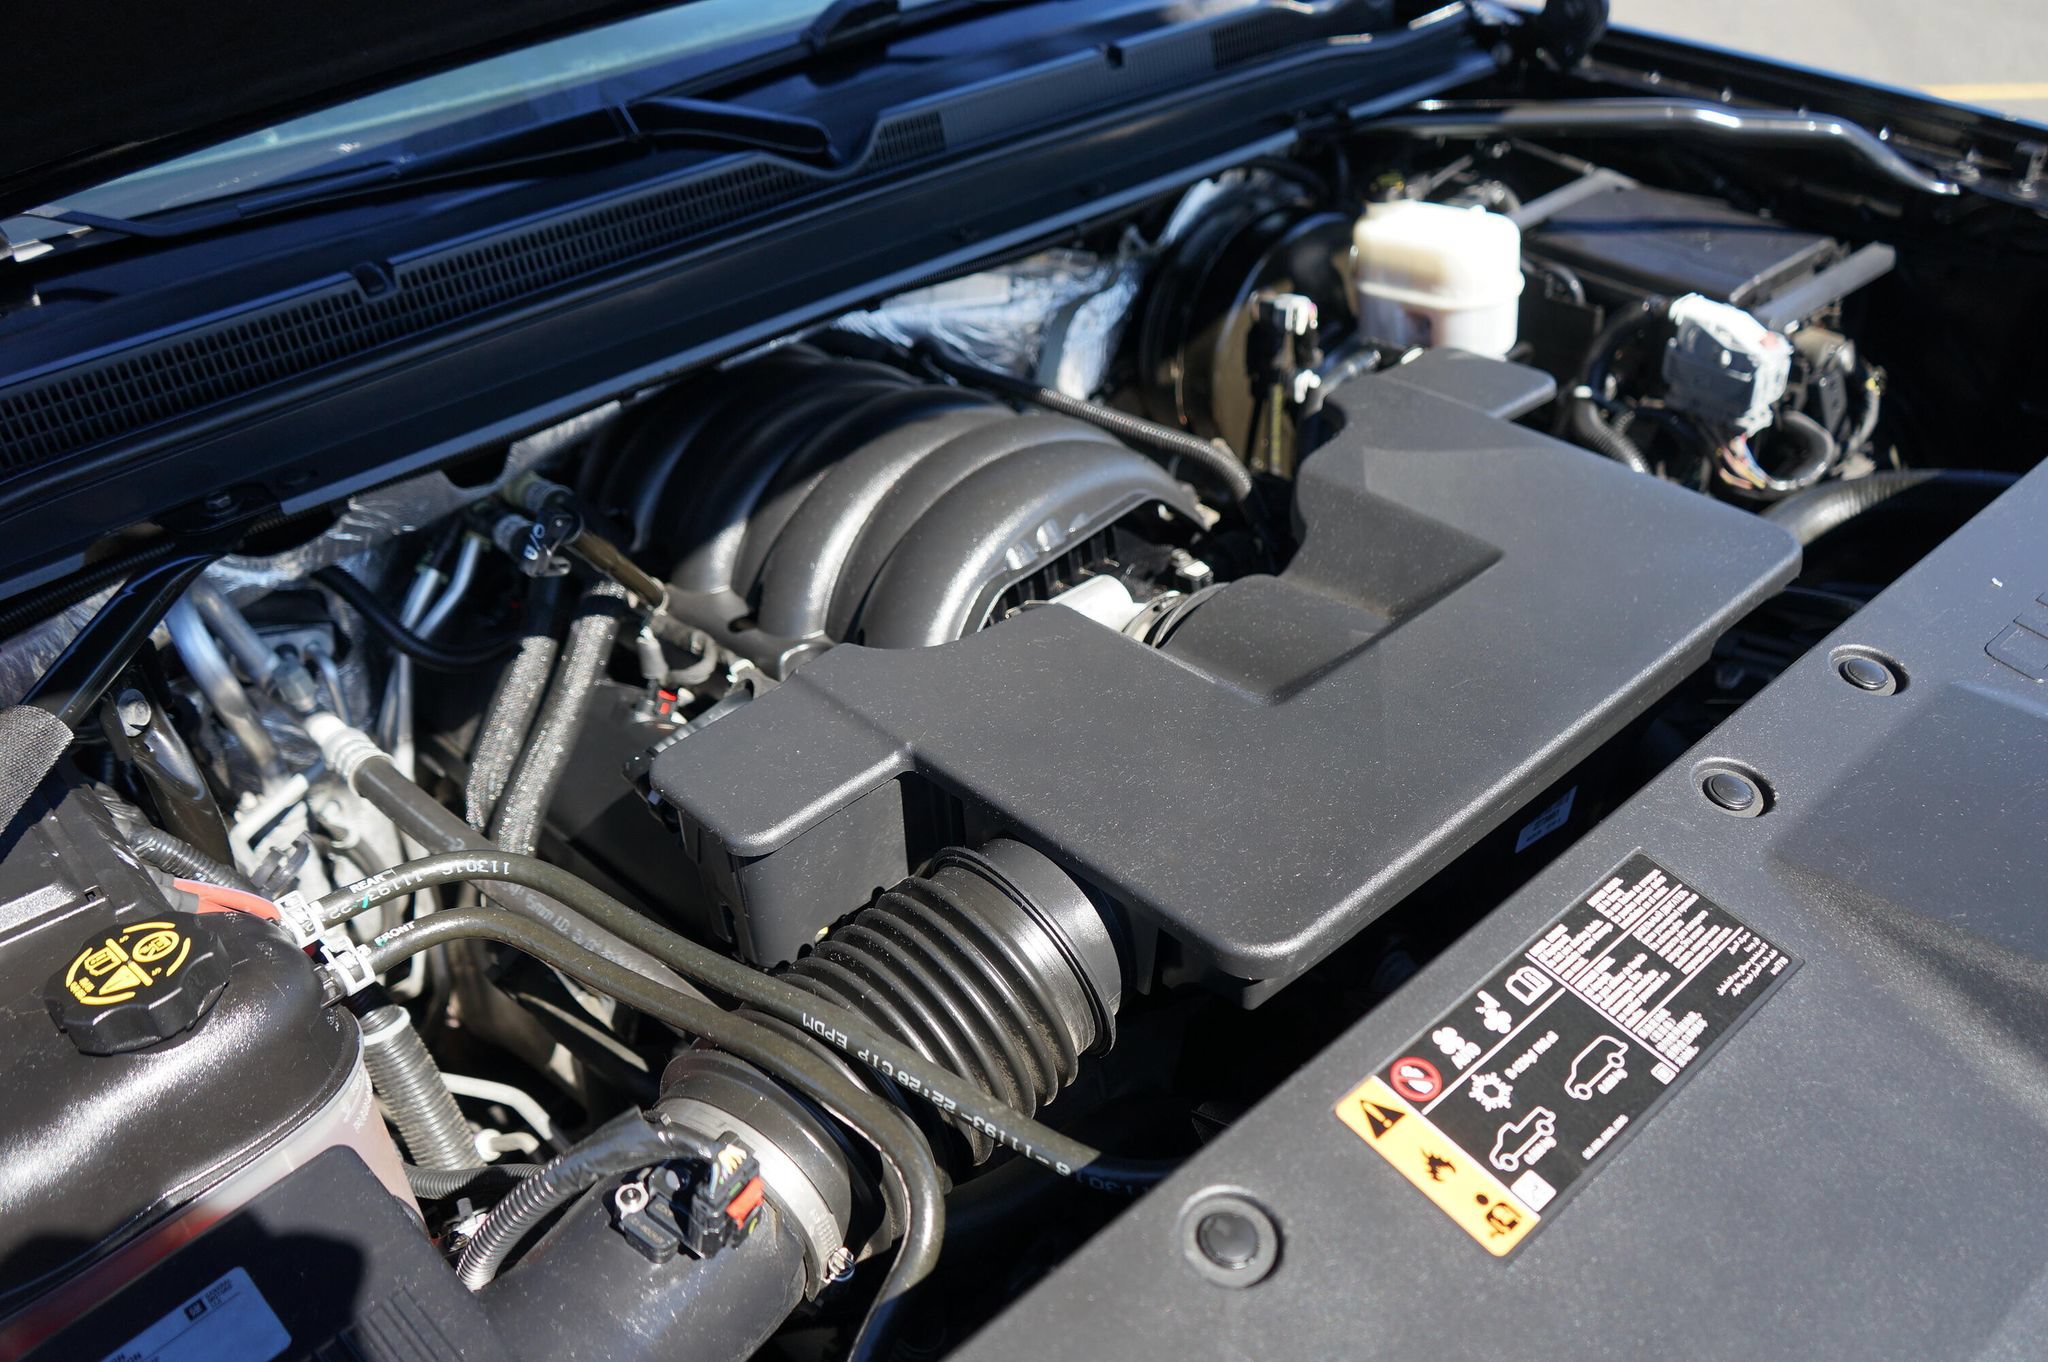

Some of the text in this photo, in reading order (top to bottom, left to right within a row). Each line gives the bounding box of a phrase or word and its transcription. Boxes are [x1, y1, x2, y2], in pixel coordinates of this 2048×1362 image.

[349, 873, 387, 894] REAR
[374, 920, 416, 947] FRONT
[802, 1012, 849, 1050] EPDM
